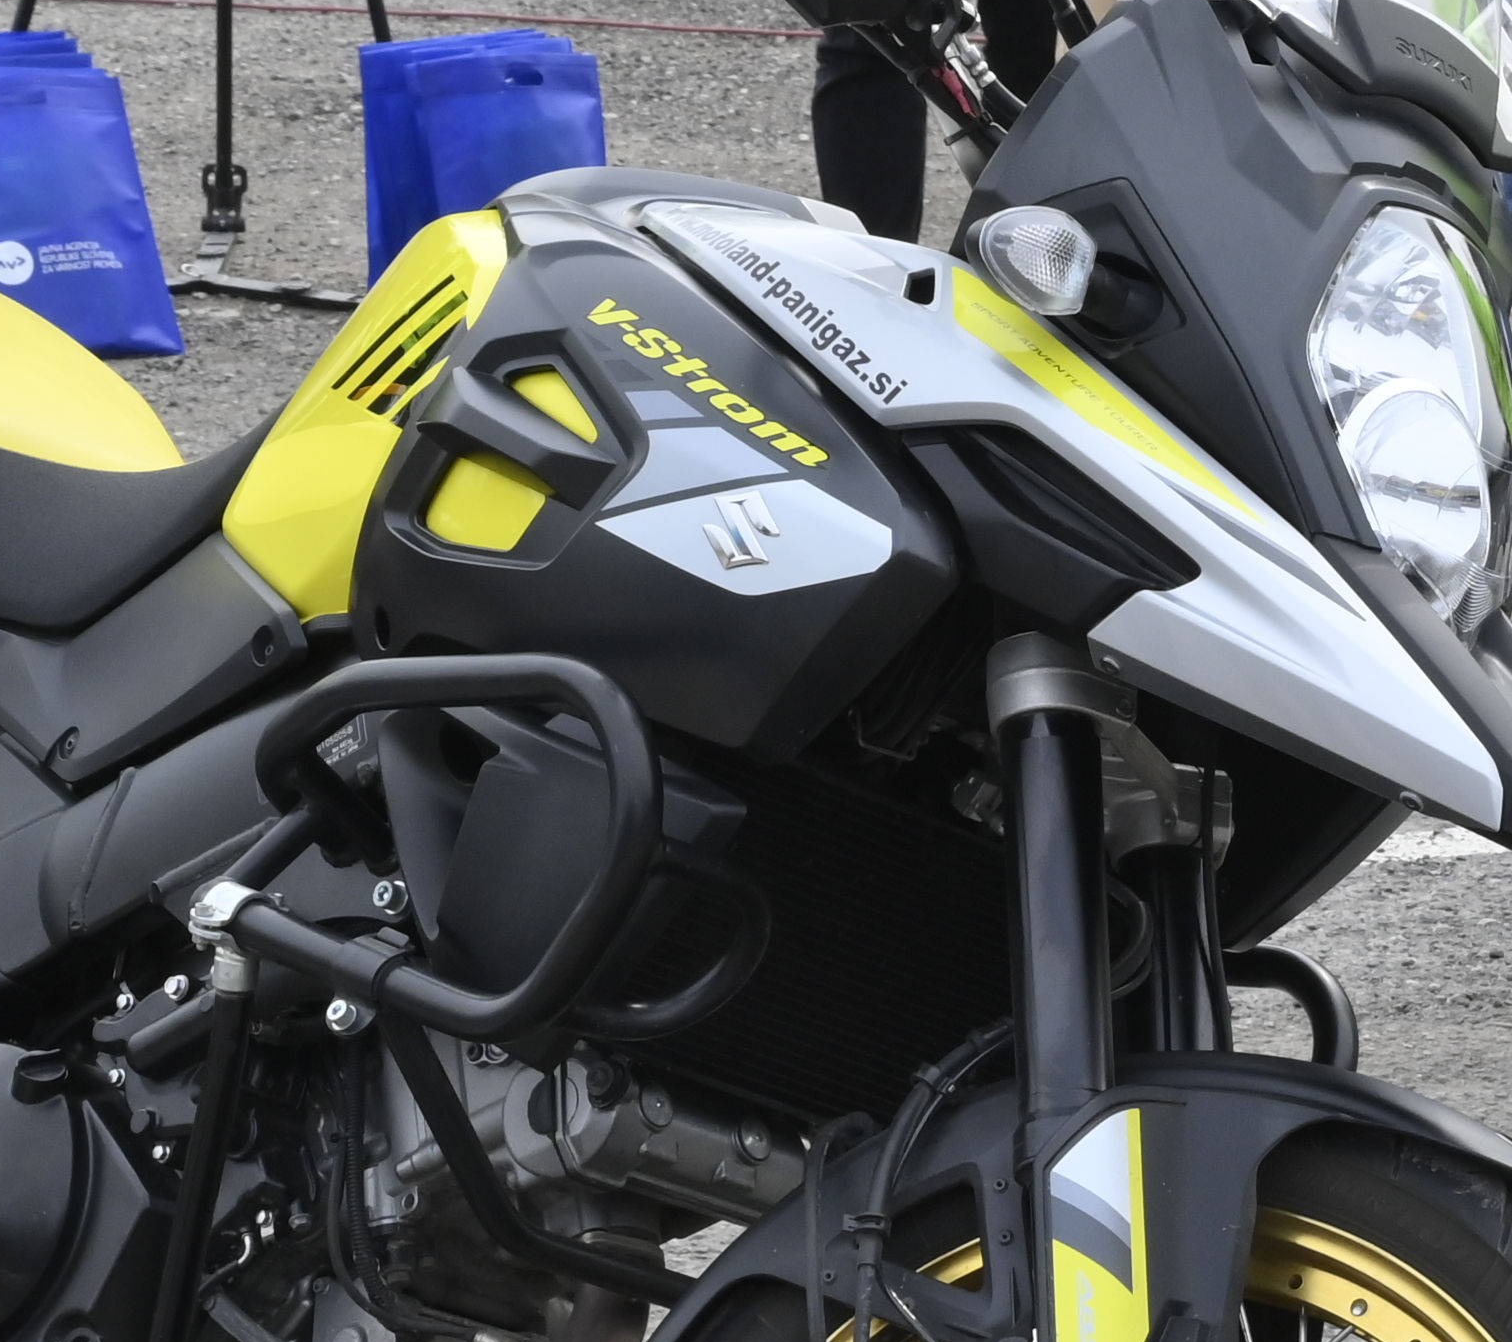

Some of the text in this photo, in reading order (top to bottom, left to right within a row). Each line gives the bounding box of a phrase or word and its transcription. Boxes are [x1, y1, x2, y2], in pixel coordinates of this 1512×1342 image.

[1394, 36, 1474, 94] SUZUKI
[970, 301, 1158, 451] SPORT ADVENTURE TOURER
